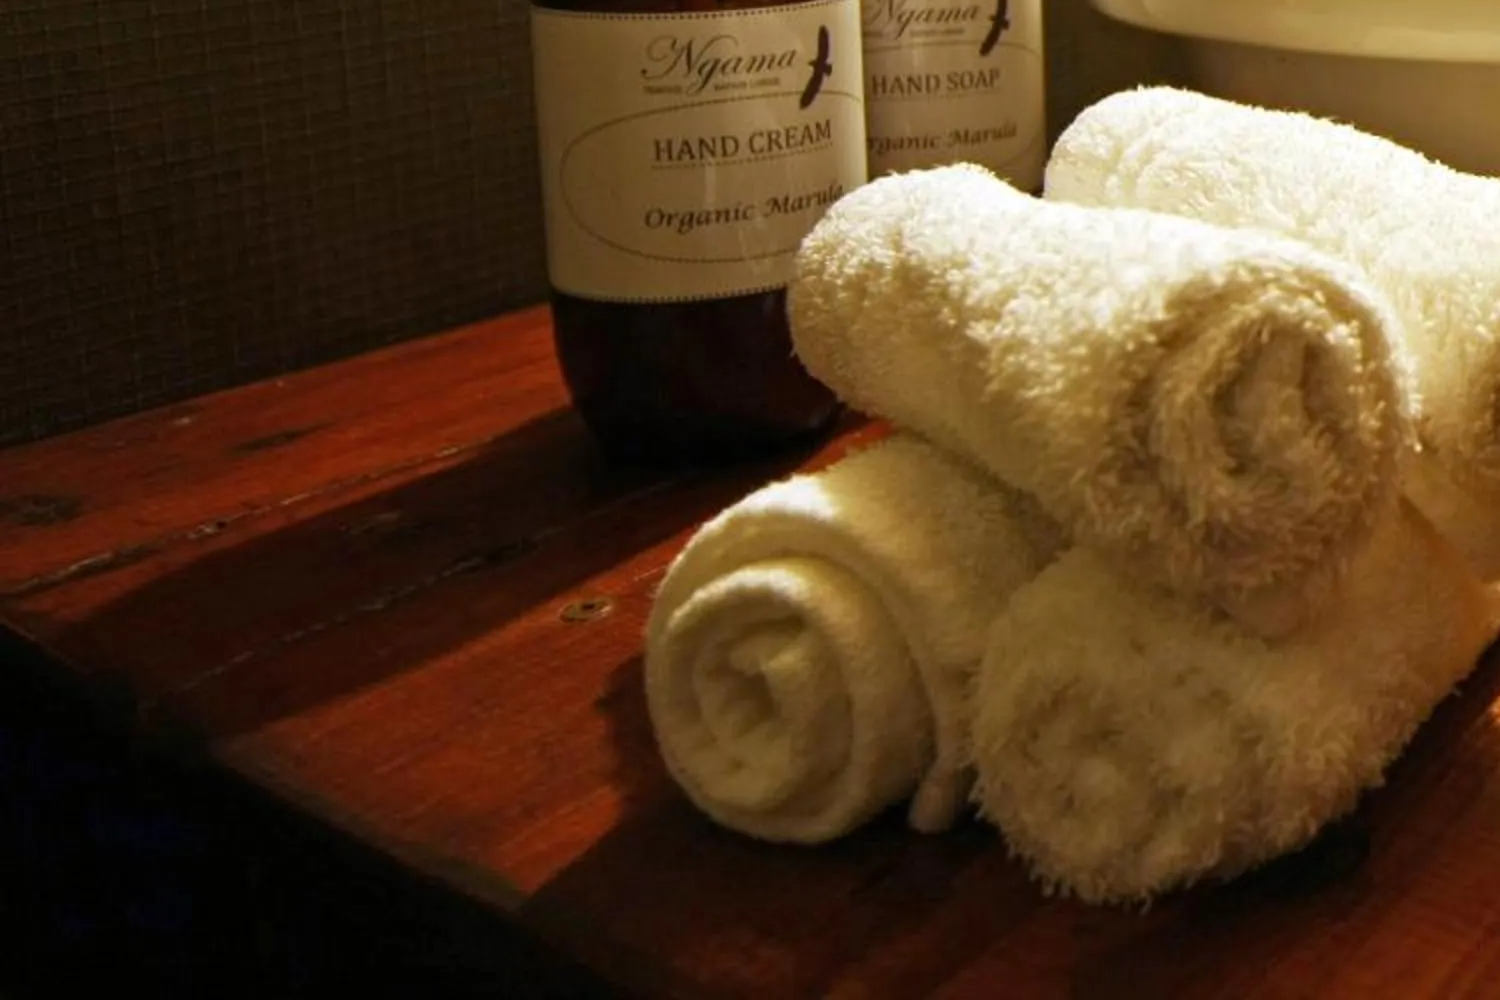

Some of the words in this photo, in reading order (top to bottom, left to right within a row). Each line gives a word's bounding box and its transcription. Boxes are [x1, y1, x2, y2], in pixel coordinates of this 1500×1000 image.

[640, 34, 798, 97] Ngama
[871, 73, 940, 96] HAND
[946, 67, 1000, 91] SOAP
[653, 135, 740, 162] HAND
[748, 119, 832, 155] CREAM
[866, 132, 942, 156] rganic
[946, 120, 1018, 147] Marula
[644, 201, 755, 236] Organic
